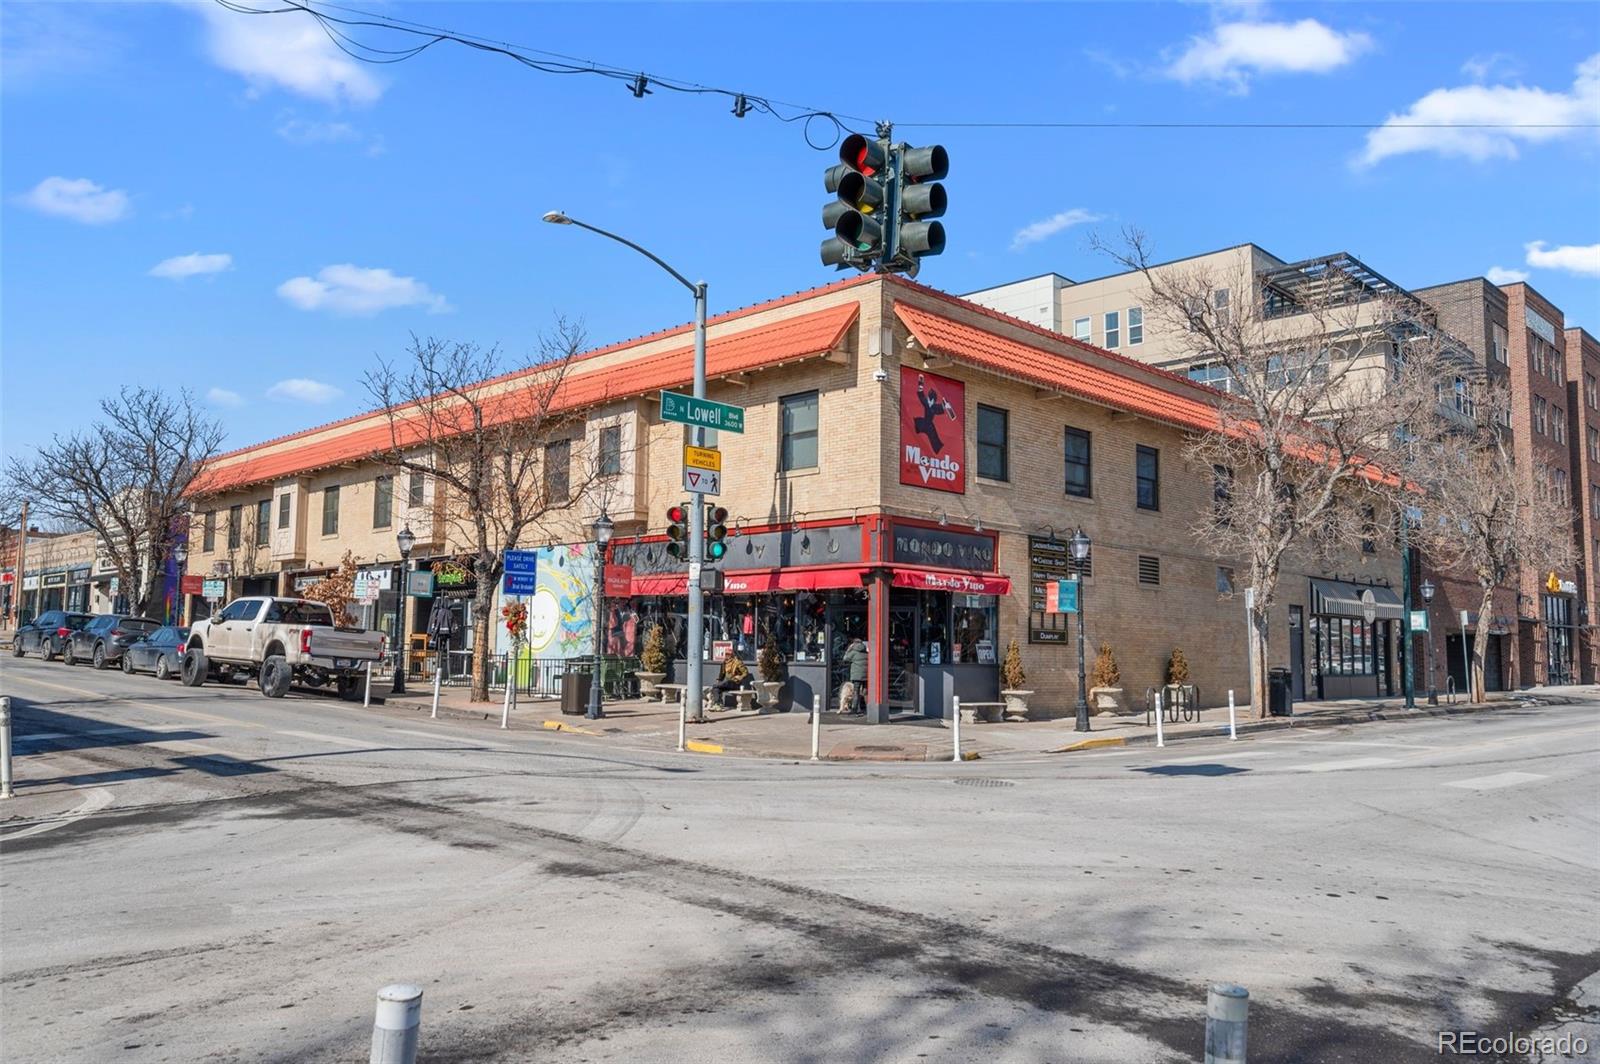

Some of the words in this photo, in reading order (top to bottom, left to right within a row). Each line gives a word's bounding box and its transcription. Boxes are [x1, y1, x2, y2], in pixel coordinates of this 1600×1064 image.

[687, 401, 720, 424] Lowell
[728, 412, 738, 420] Blvd
[692, 459, 715, 468] VEHICLES
[694, 450, 714, 460] TURNING
[906, 445, 960, 472] Mondo
[919, 466, 956, 484] Vino
[896, 538, 953, 557] MONDO
[958, 544, 991, 560] VINO
[723, 579, 747, 589] Vino
[925, 574, 960, 588] Mondo
[962, 577, 984, 590] Vino
